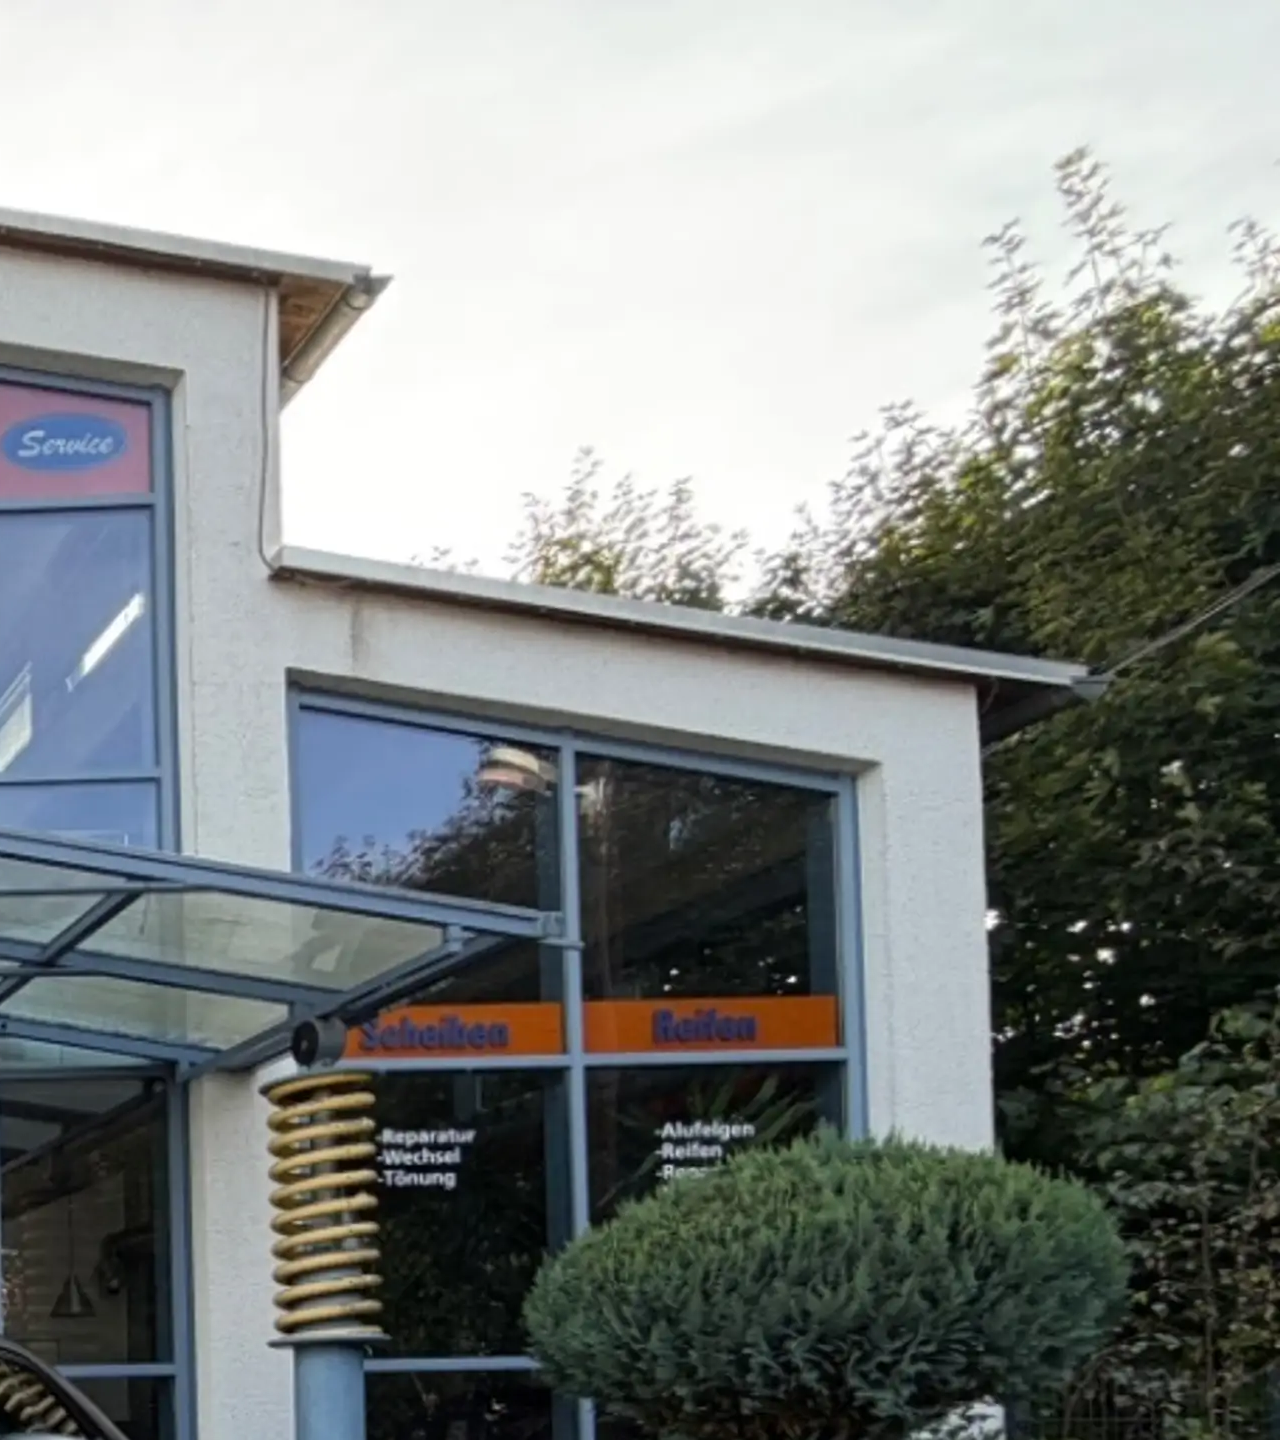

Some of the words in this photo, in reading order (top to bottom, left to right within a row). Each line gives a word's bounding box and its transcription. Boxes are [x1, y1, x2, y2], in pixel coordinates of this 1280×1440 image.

[17, 430, 114, 457] Service
[359, 1018, 510, 1052] Scheiben
[652, 1008, 758, 1045] Reifen
[375, 1128, 477, 1149] -Reparatur
[654, 1120, 756, 1142] -Alufelgen
[376, 1146, 461, 1166] -Wechsel
[655, 1141, 723, 1160] -Reifen
[377, 1168, 457, 1191] -Tönung
